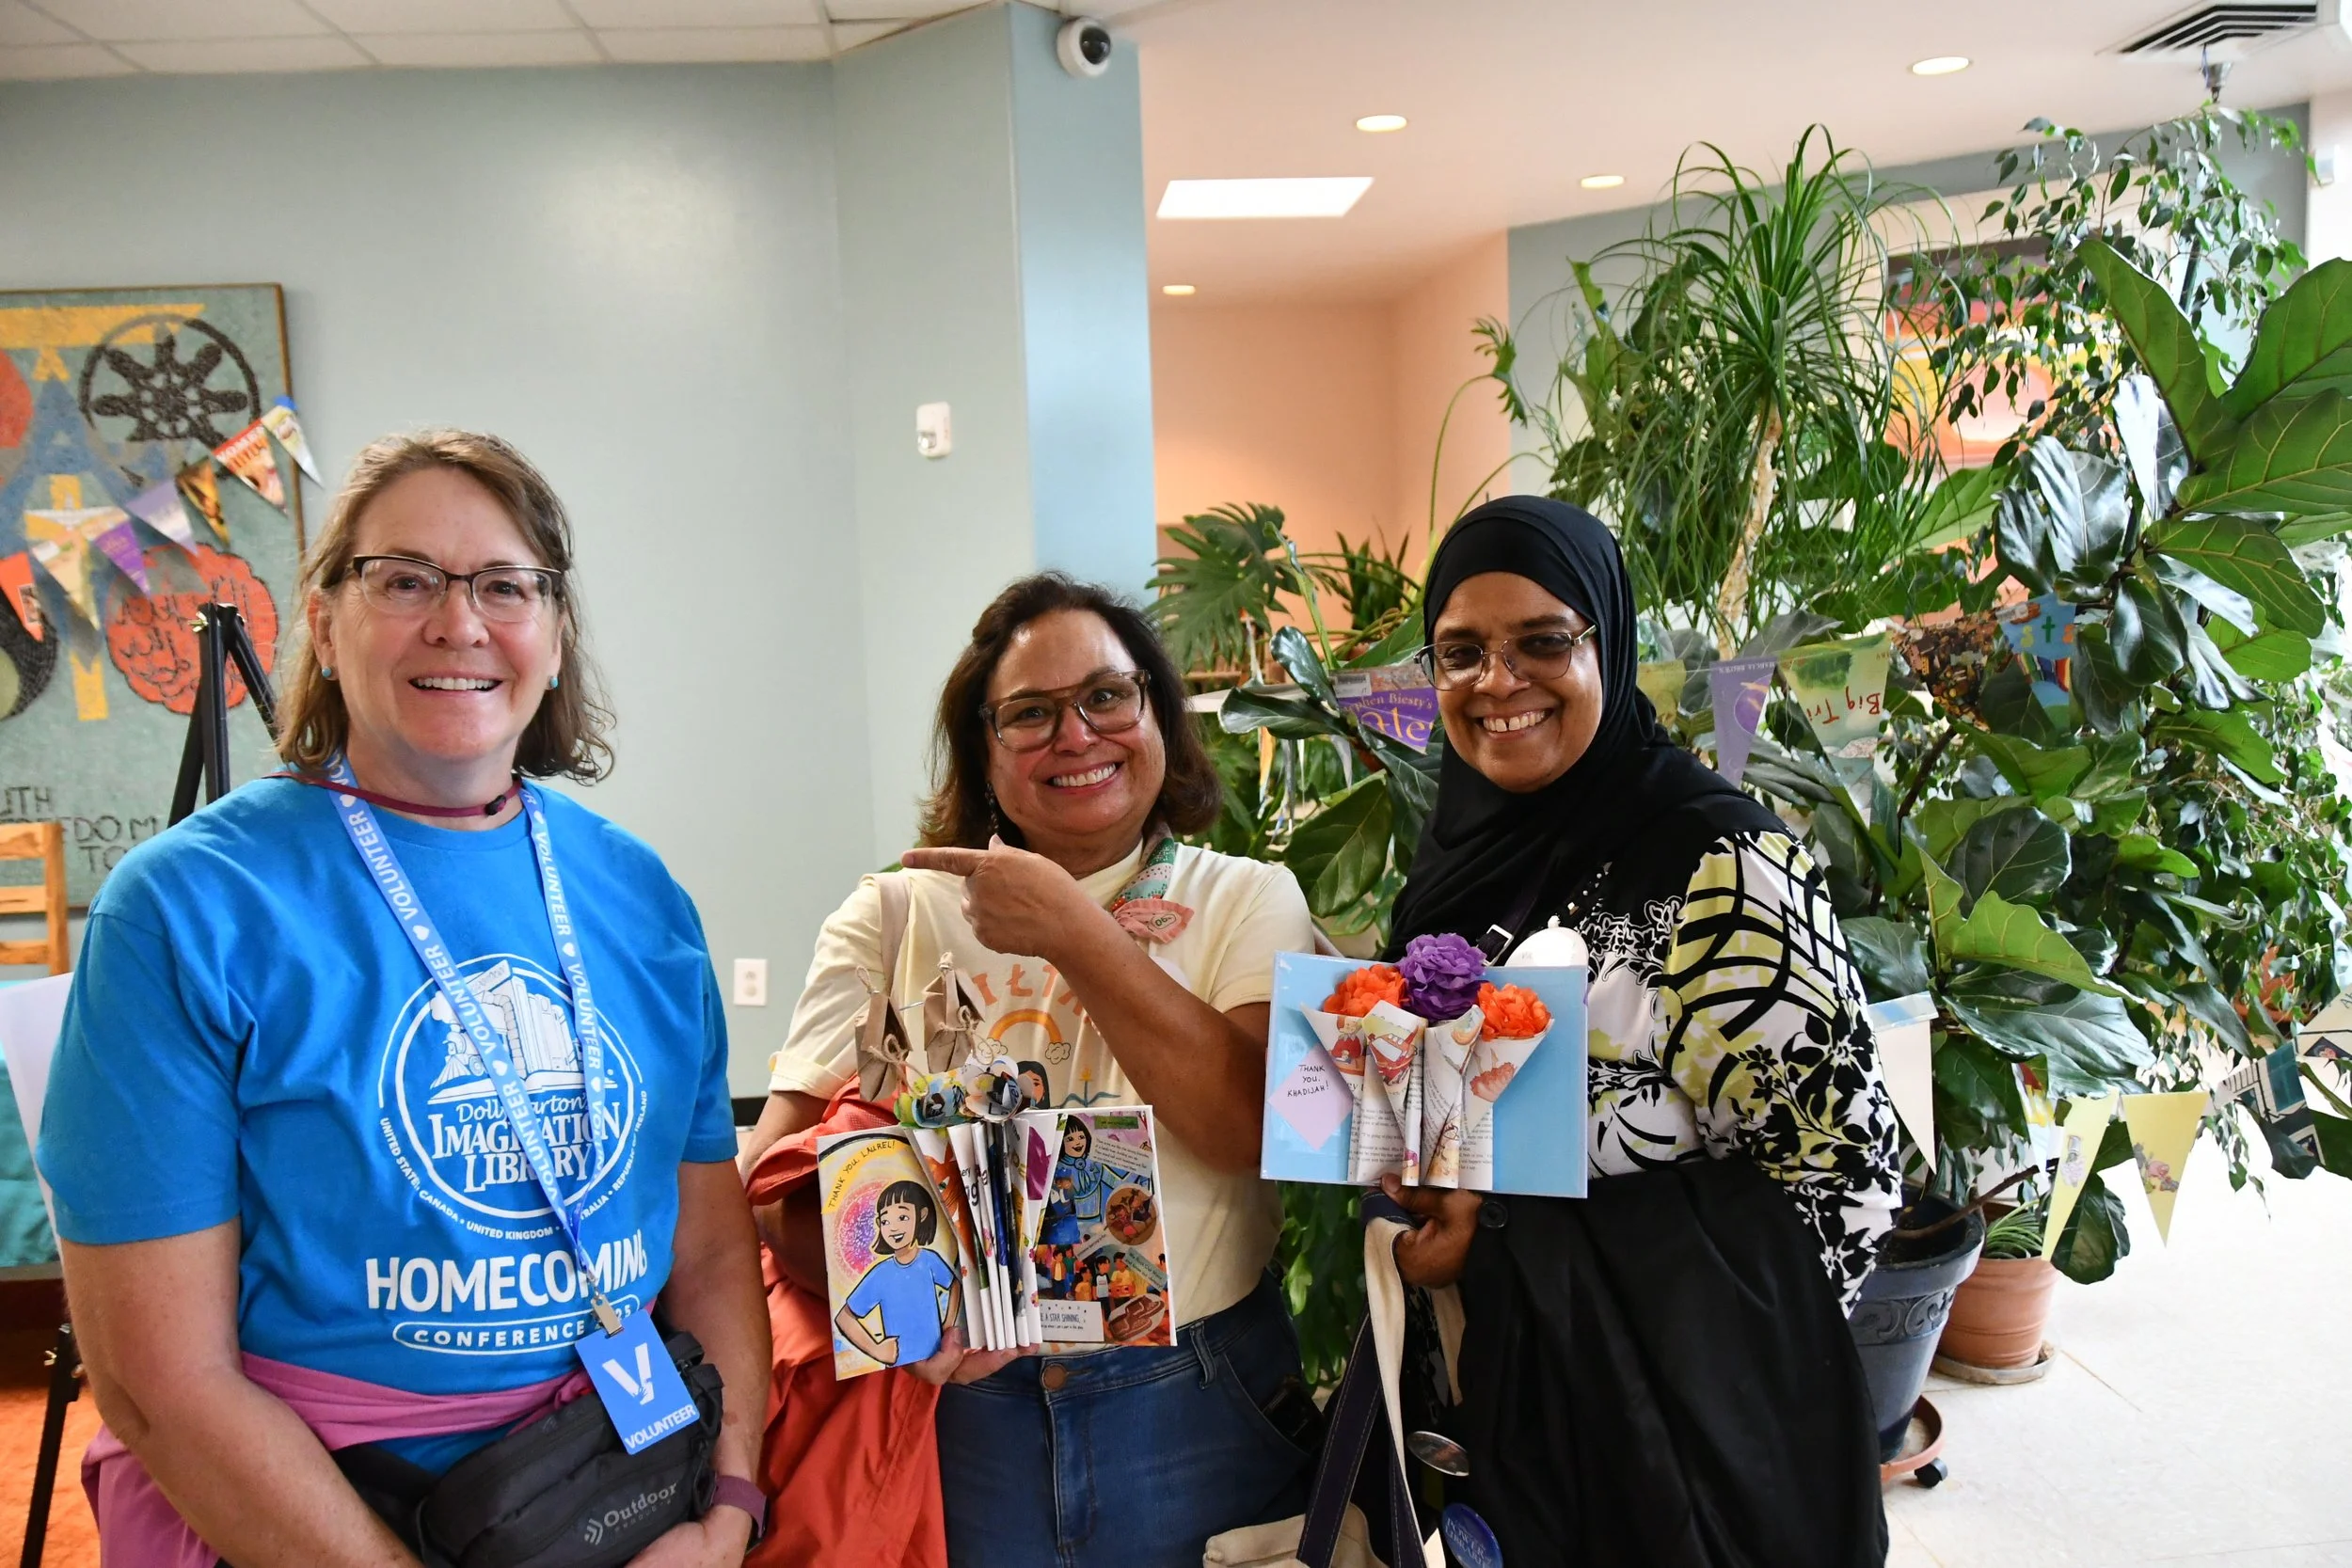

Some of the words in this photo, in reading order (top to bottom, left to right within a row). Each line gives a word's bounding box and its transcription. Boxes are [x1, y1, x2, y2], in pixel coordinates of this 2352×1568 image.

[1389, 692, 1433, 710] Biesty's
[1846, 686, 1881, 715] Big
[348, 811, 418, 921] VOLUNTEER
[534, 832, 571, 936] VOLUNTEER
[424, 944, 497, 1054] VOLUNTEER
[567, 963, 600, 1069] VOLUNTEER
[1287, 1080, 1329, 1097] KHADIJAH!
[1298, 1064, 1326, 1072] THANK
[530, 1092, 587, 1115] arton'
[380, 1117, 401, 1156] UNITED
[503, 1081, 559, 1201] VOLUNTEER
[464, 1143, 593, 1193] LIBRRY
[828, 1177, 845, 1209] THANK
[860, 1140, 896, 1158] LAUREL!
[419, 1190, 459, 1222] CANADA
[467, 1221, 502, 1239] UNITED
[505, 1226, 553, 1241] KINGDOM
[414, 1320, 585, 1348] CONFERENCE
[624, 1403, 696, 1449] VOLUNTEER
[603, 1482, 677, 1528] Outdoor
